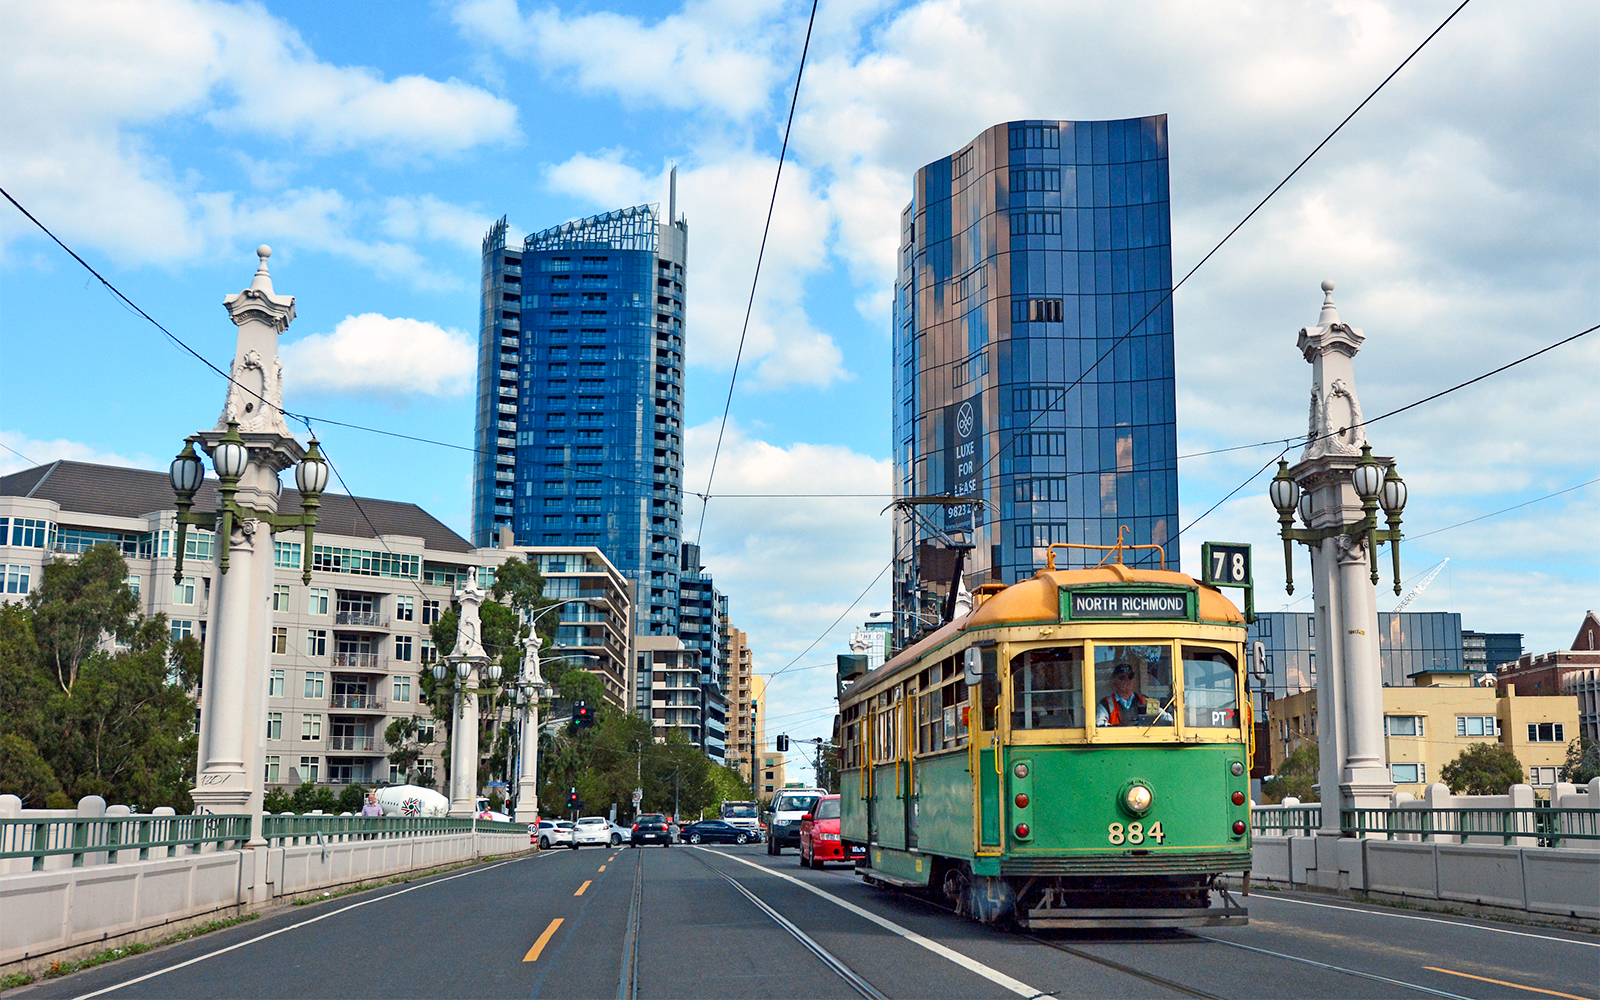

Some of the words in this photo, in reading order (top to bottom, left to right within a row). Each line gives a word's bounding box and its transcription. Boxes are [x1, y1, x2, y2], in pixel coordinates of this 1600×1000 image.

[956, 441, 975, 459] LUXE
[958, 461, 973, 477] FOR
[954, 479, 977, 497] LEASE
[948, 504, 967, 518] 9823
[1213, 552, 1245, 581] 78
[1076, 597, 1118, 611] NORTH
[1122, 597, 1184, 611] RICHMOND
[1108, 821, 1166, 846] 884
